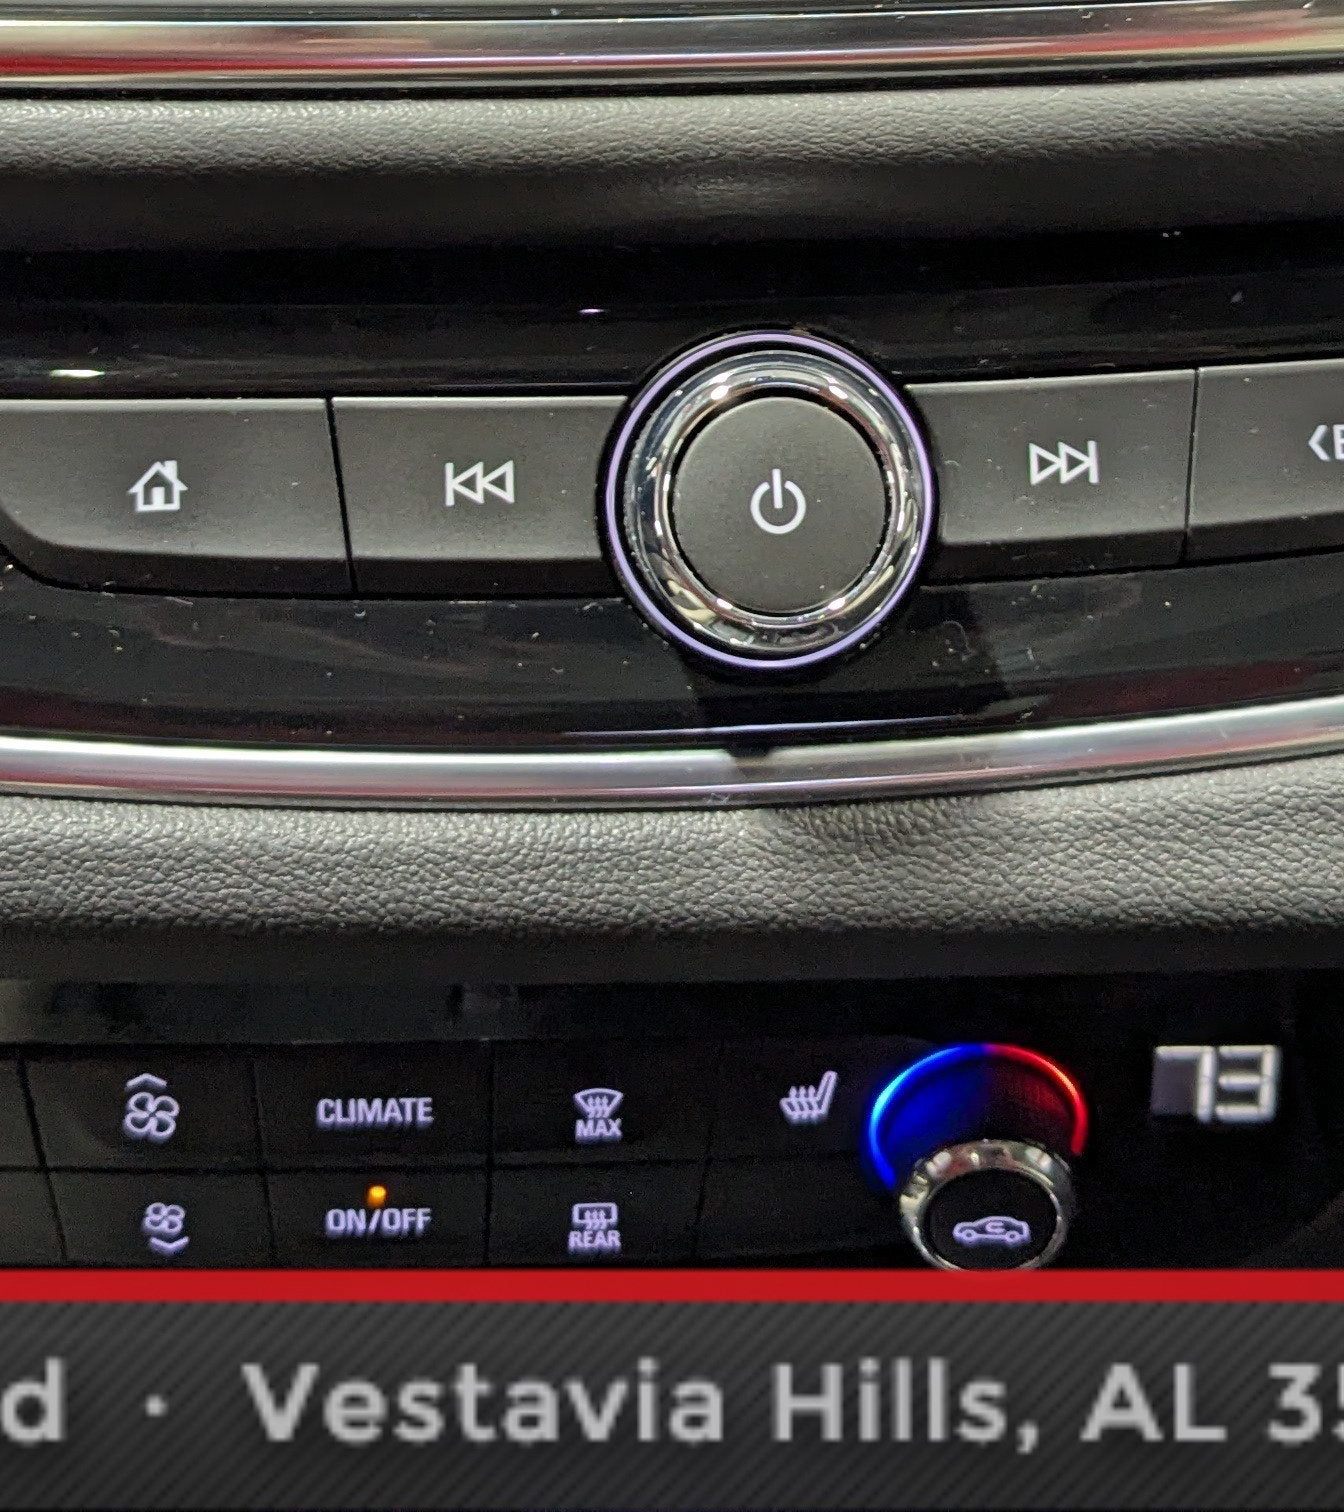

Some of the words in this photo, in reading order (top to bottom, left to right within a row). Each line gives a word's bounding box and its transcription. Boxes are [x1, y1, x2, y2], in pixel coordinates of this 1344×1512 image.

[1152, 1044, 1281, 1124] 73
[316, 1096, 435, 1129] CLIMATE
[575, 1118, 623, 1141] MAX
[325, 1206, 432, 1238] ON/OFF
[568, 1229, 621, 1253] REAR
